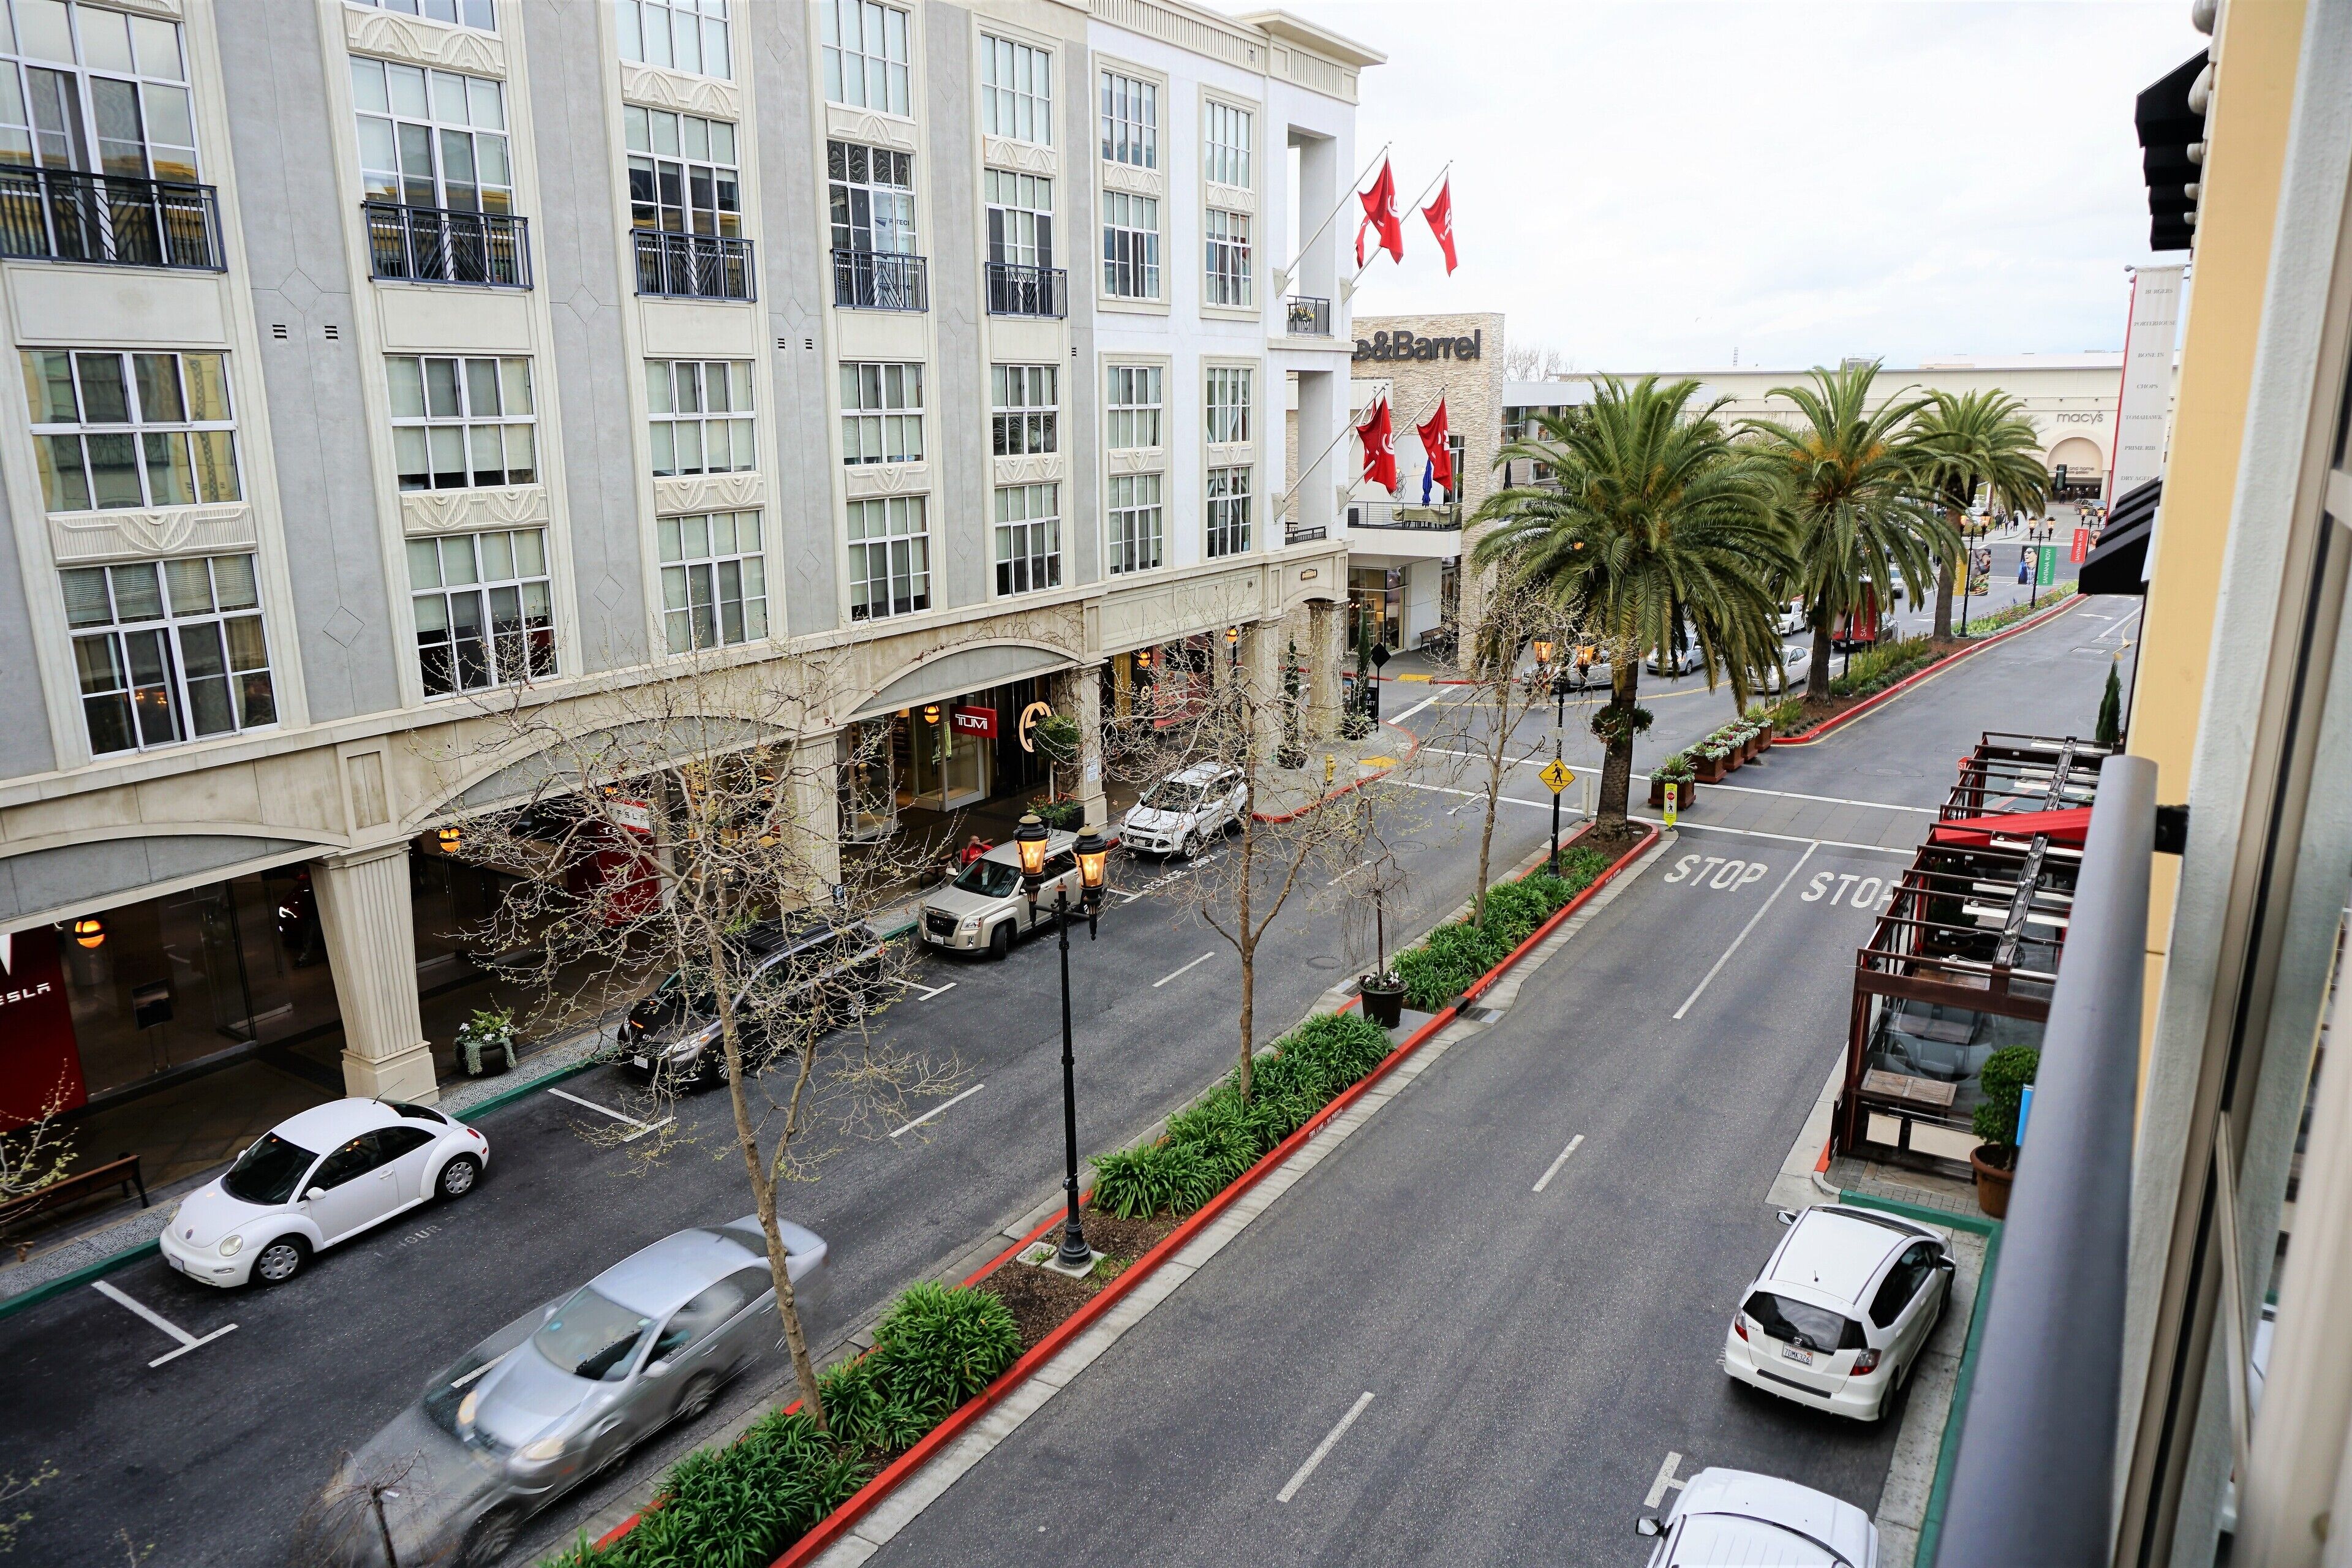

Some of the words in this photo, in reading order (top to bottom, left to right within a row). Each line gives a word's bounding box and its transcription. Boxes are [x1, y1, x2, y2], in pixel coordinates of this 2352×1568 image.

[1351, 329, 1481, 361] e&Barrel
[2057, 411, 2103, 424] macy's
[956, 714, 987, 729] TUMI
[1664, 854, 1768, 892] STOP
[1785, 1348, 1811, 1363] 7DMK326
